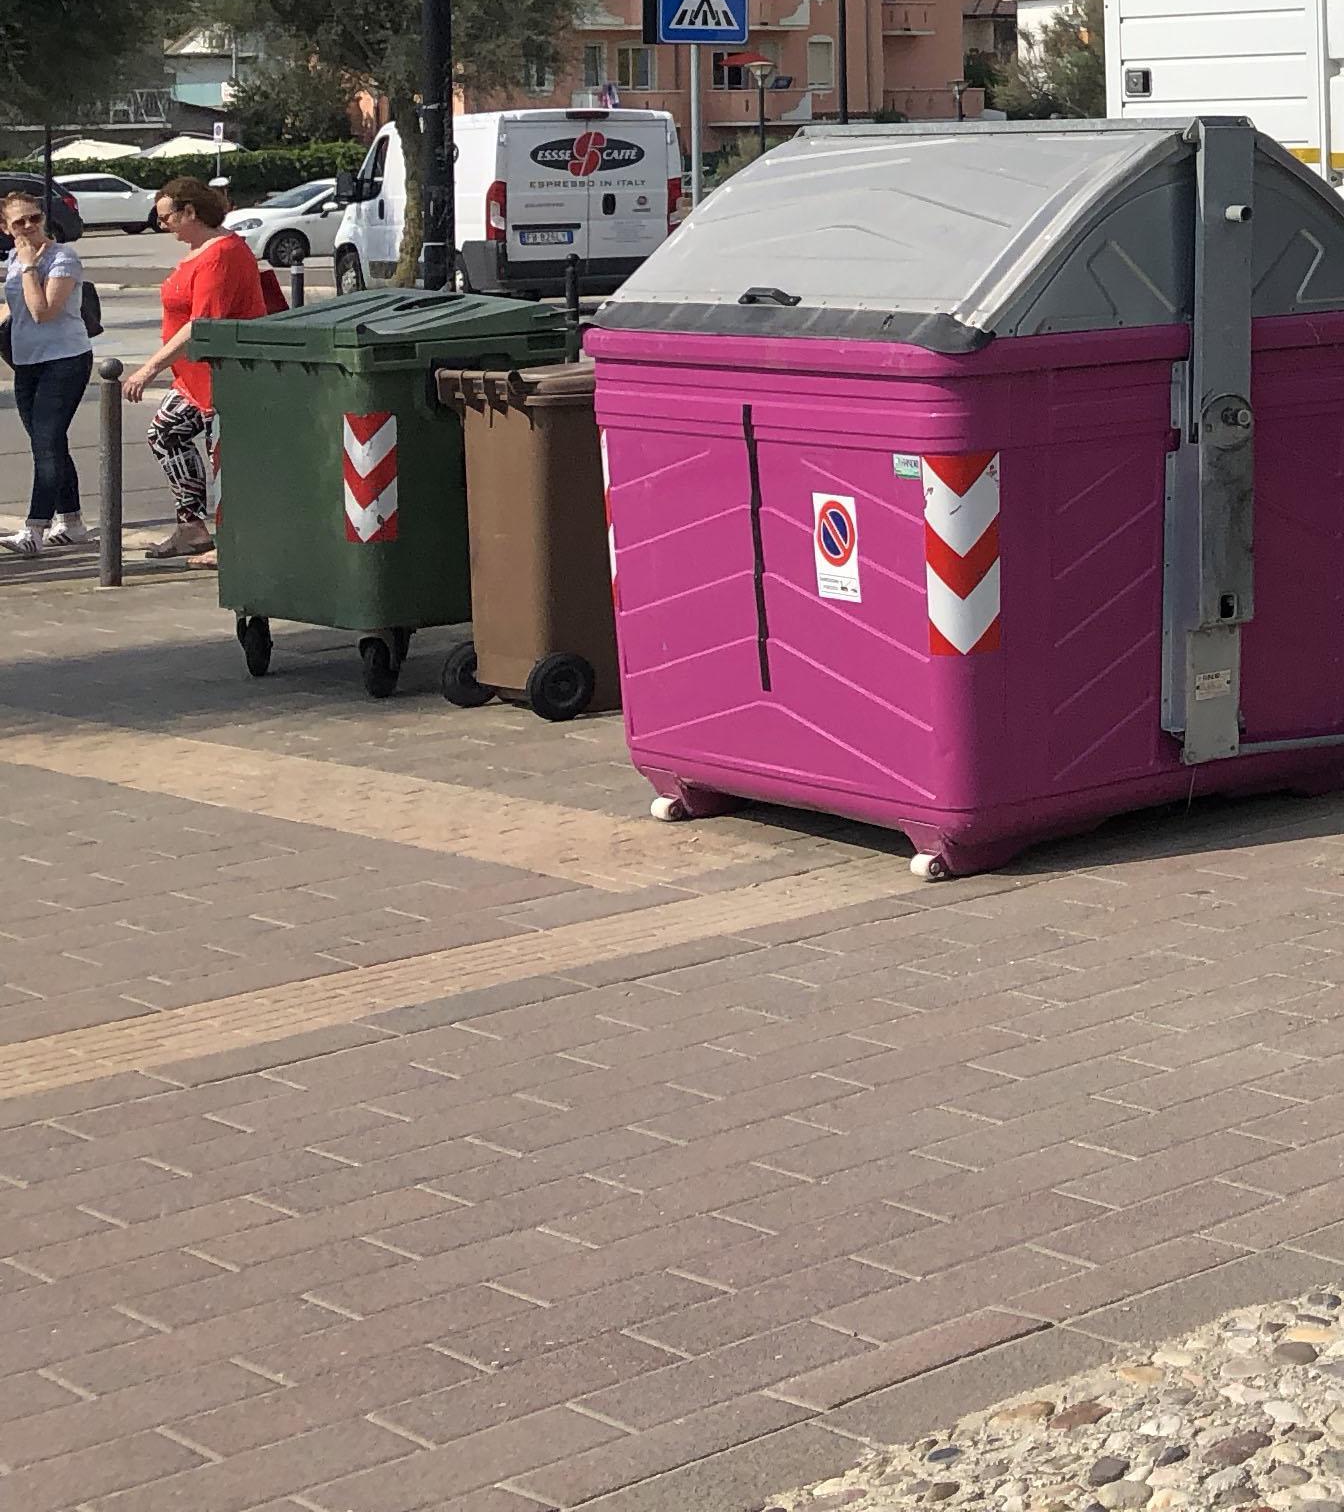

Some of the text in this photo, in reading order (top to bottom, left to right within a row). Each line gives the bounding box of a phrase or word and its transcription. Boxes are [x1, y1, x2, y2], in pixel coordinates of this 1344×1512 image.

[537, 149, 572, 161] ESSSE
[529, 179, 646, 189] ESPRESSO IN ITALY
